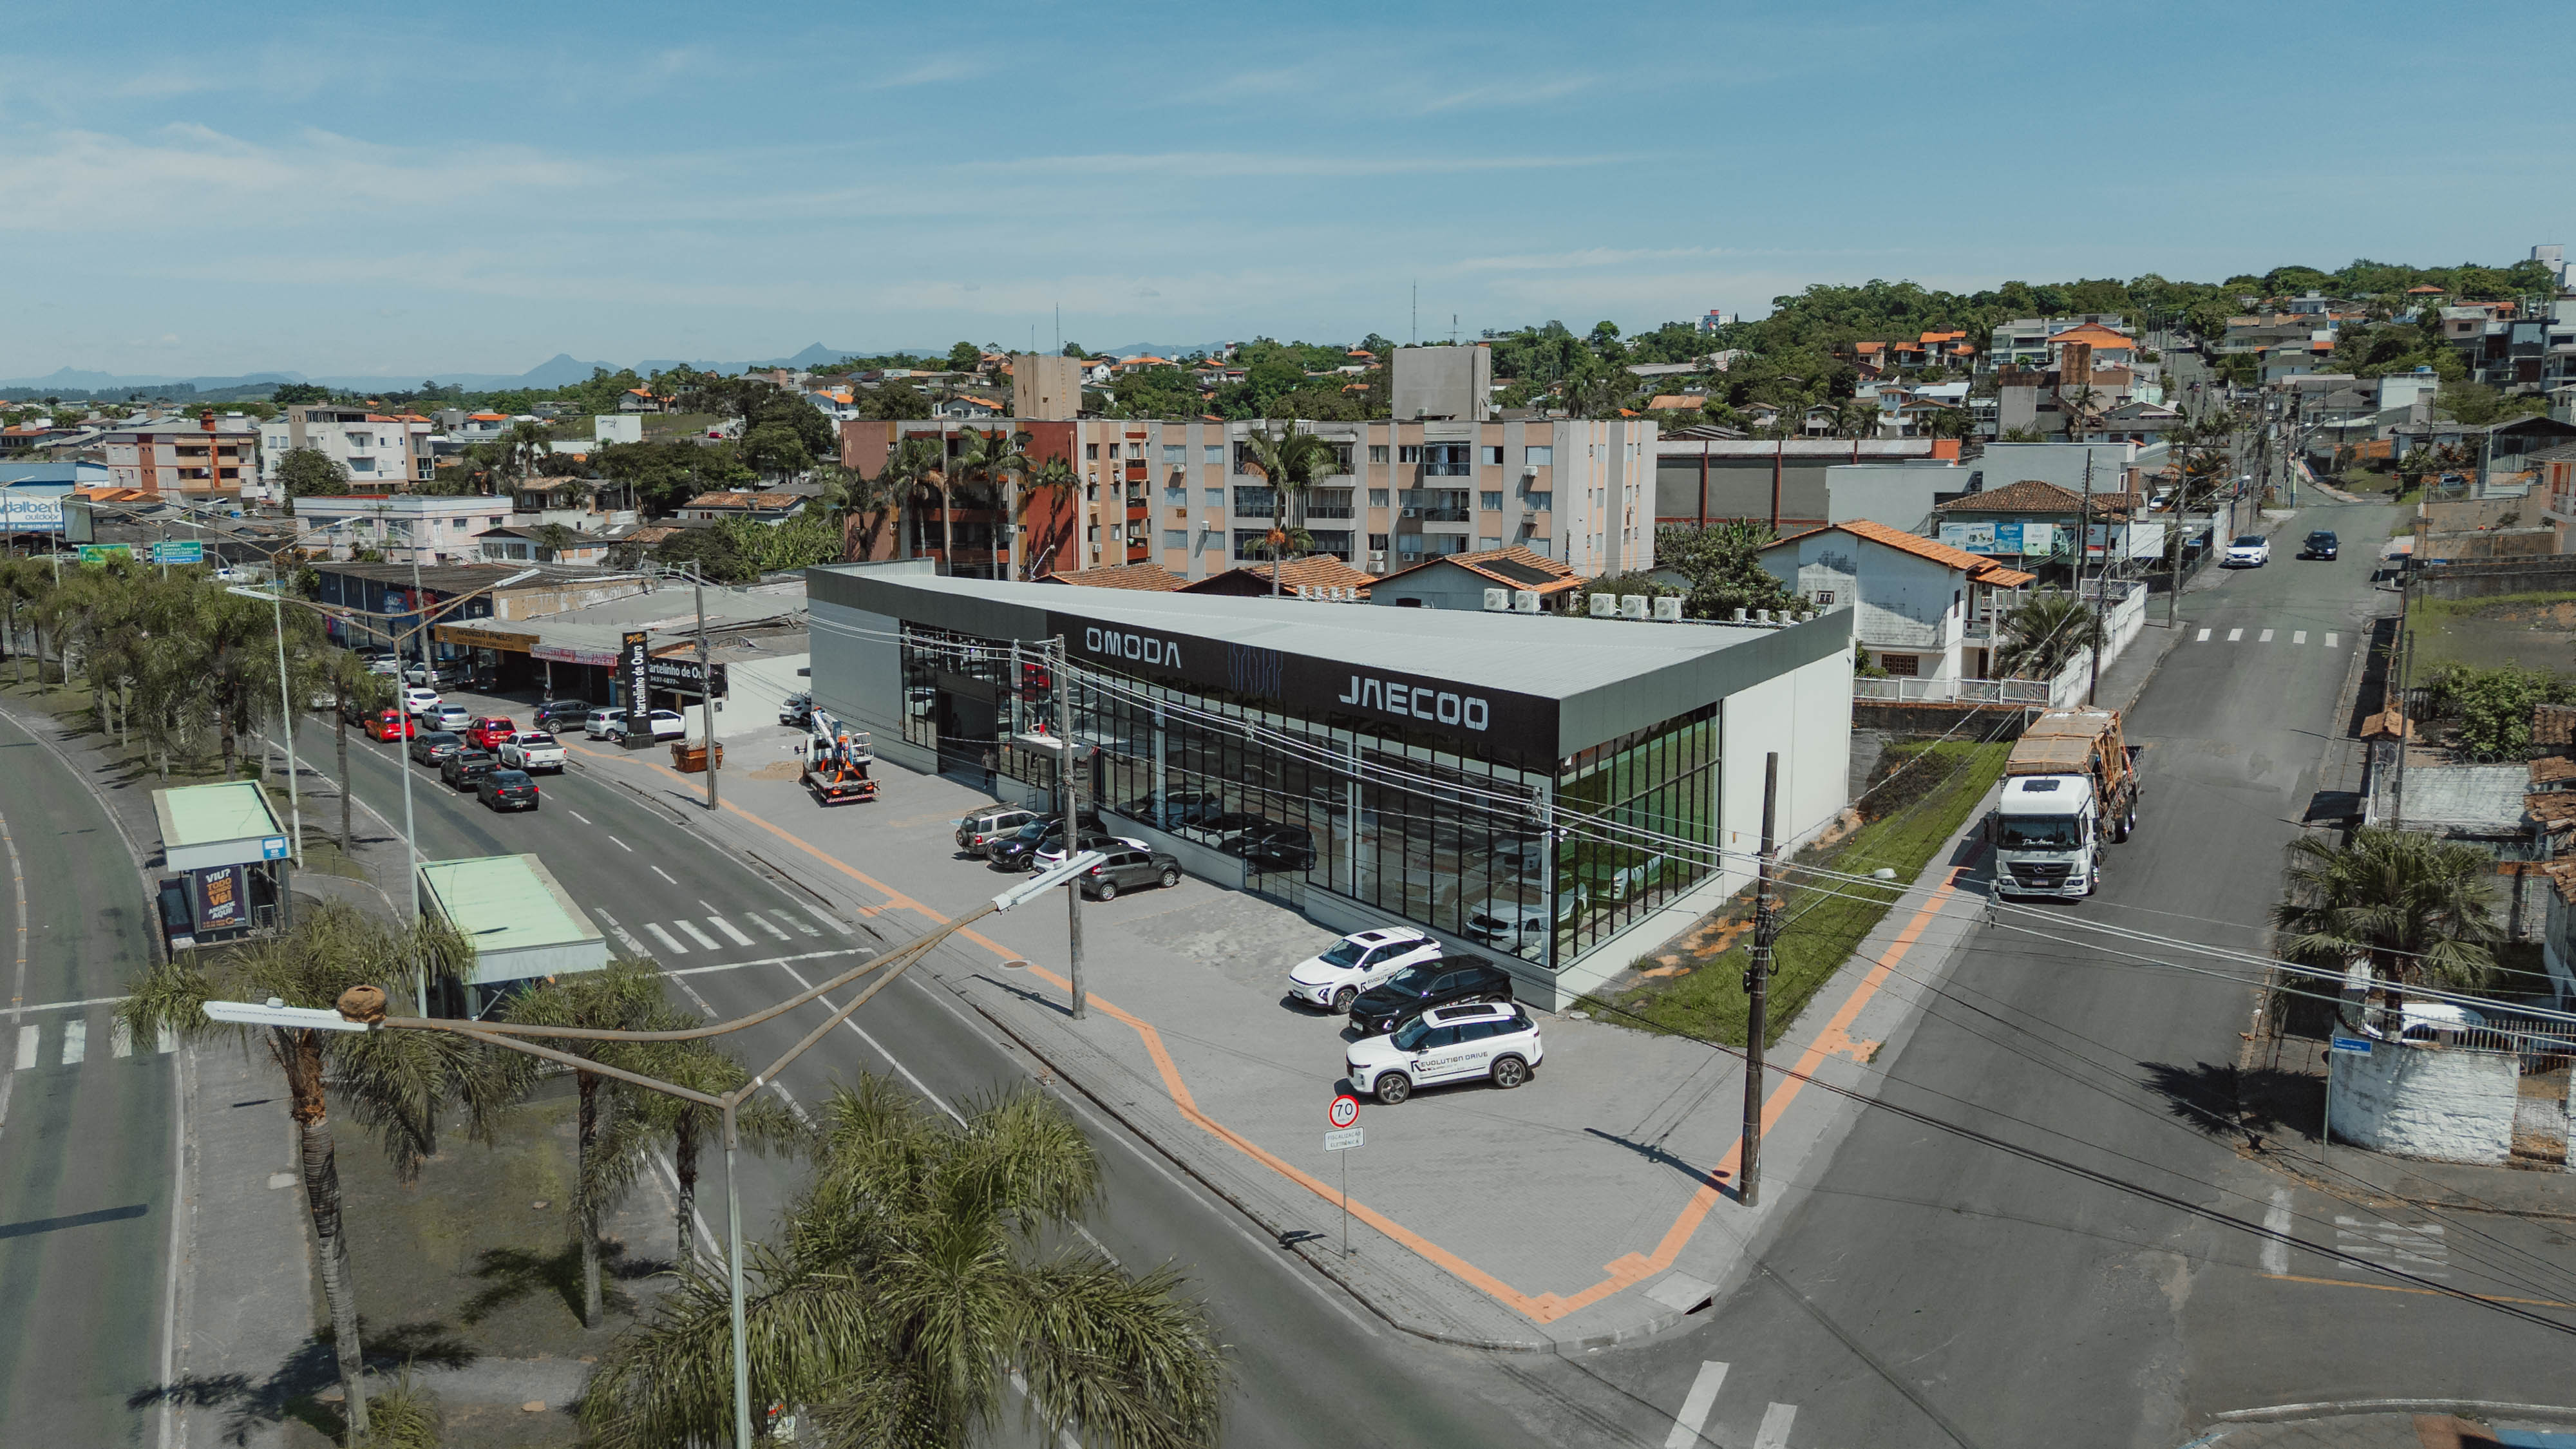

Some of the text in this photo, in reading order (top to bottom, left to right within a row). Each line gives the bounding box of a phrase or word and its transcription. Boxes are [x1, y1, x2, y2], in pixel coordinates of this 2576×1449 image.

[1086, 627, 1181, 668] OMODA
[630, 645, 643, 665] Ouro
[631, 667, 643, 676] de
[648, 662, 680, 676] artelinho
[681, 665, 691, 678] de
[632, 677, 647, 718] Martelinho
[1339, 676, 1488, 731] JAECOO
[206, 868, 231, 883] VIU?
[207, 877, 232, 891] TODO
[209, 901, 236, 914] ANUNCIE
[1465, 1051, 1488, 1060] DRIVE
[1335, 1103, 1353, 1117] 70
[1327, 1130, 1361, 1140] FISCALIZAÇÃO
